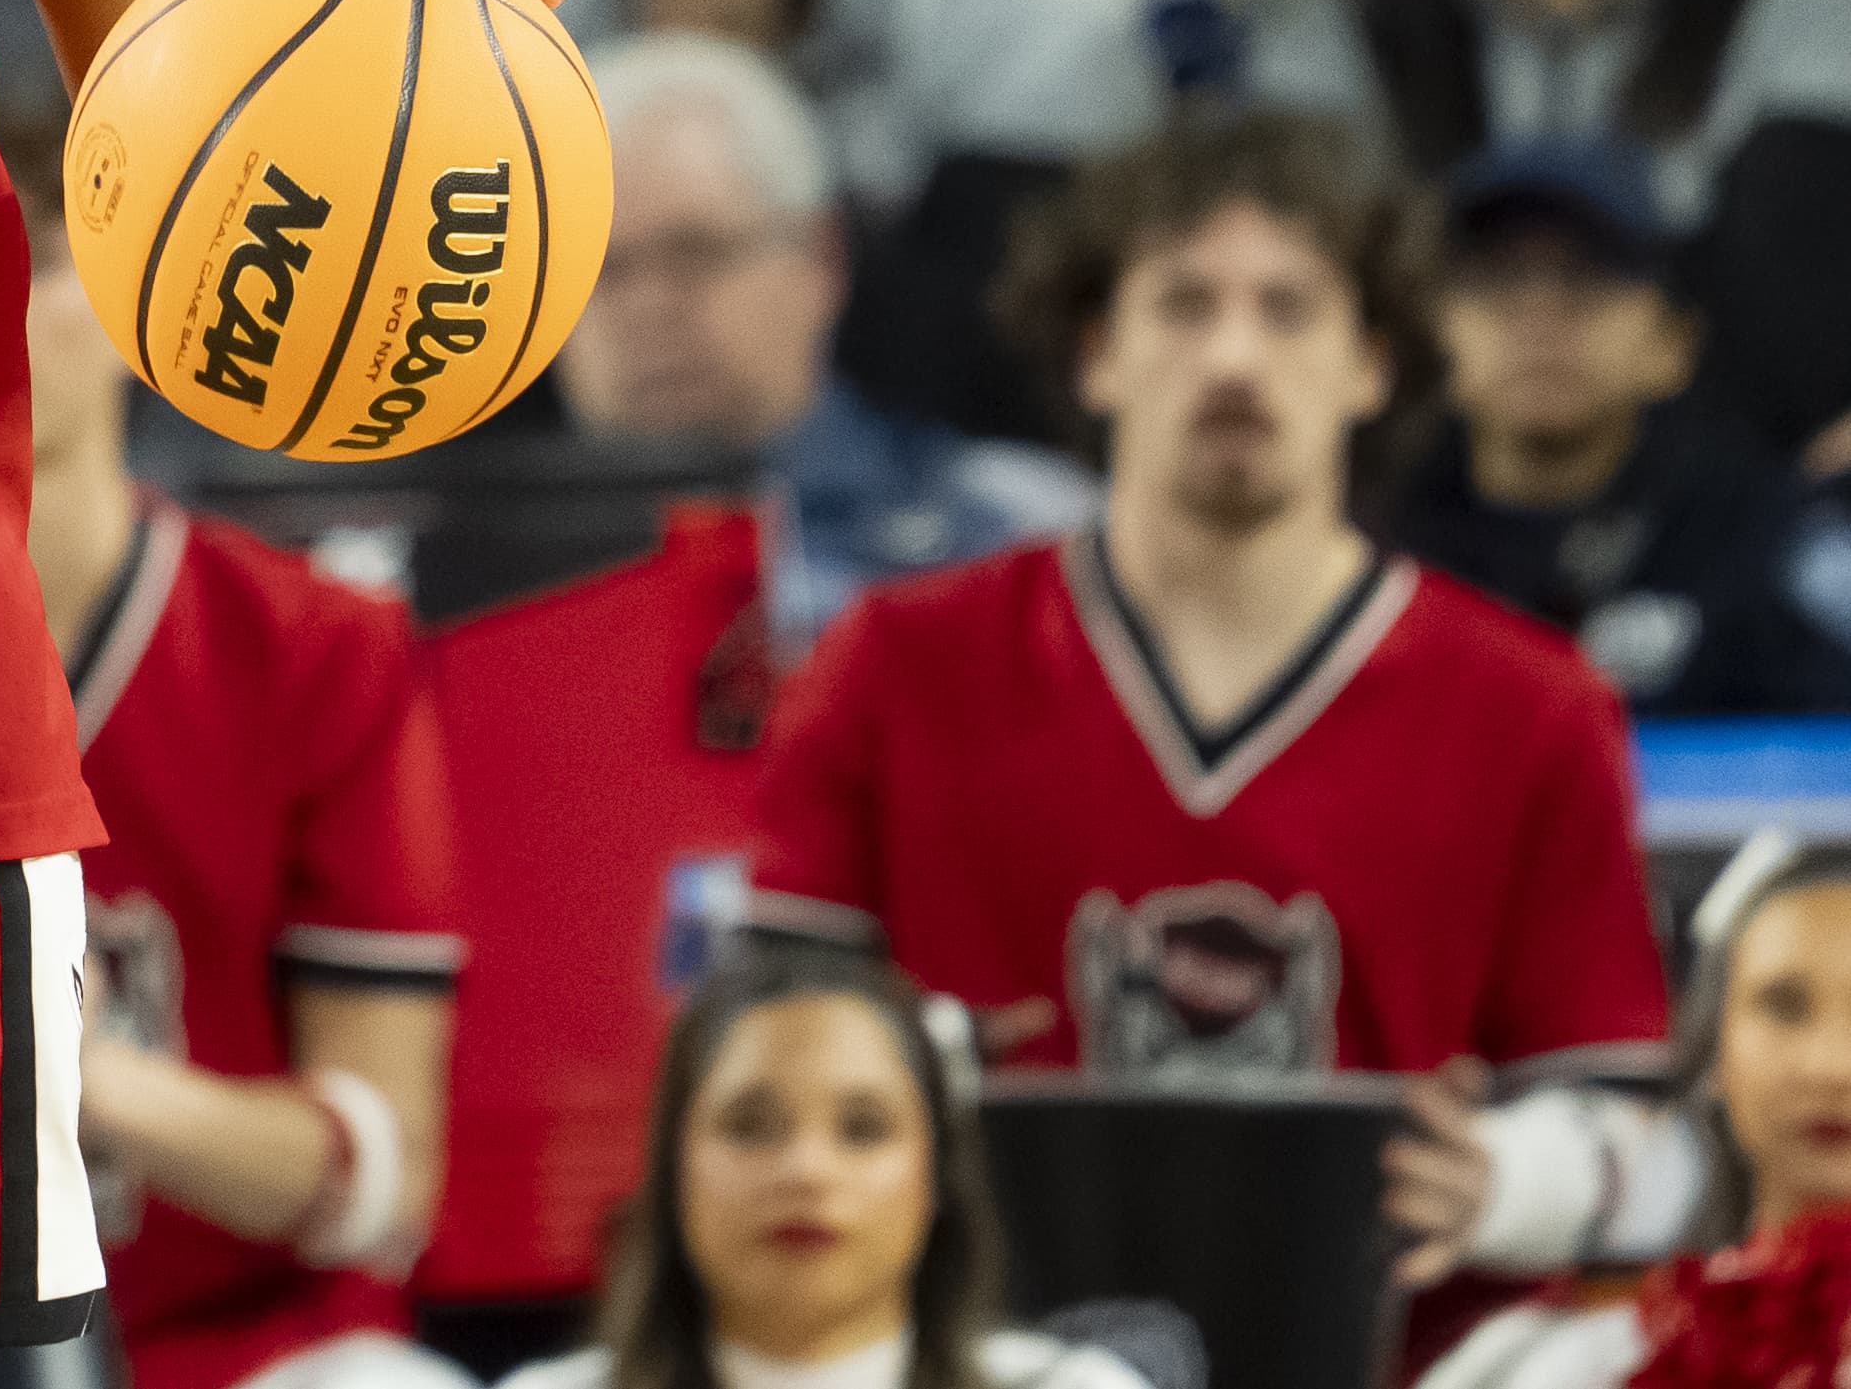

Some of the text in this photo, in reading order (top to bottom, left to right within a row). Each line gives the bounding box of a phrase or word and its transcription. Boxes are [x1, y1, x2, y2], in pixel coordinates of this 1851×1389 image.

[194, 162, 332, 407] NCAA
[208, 151, 260, 252] OFFICIAL
[329, 158, 511, 450] Wilson
[365, 286, 408, 383] EVO NXT
